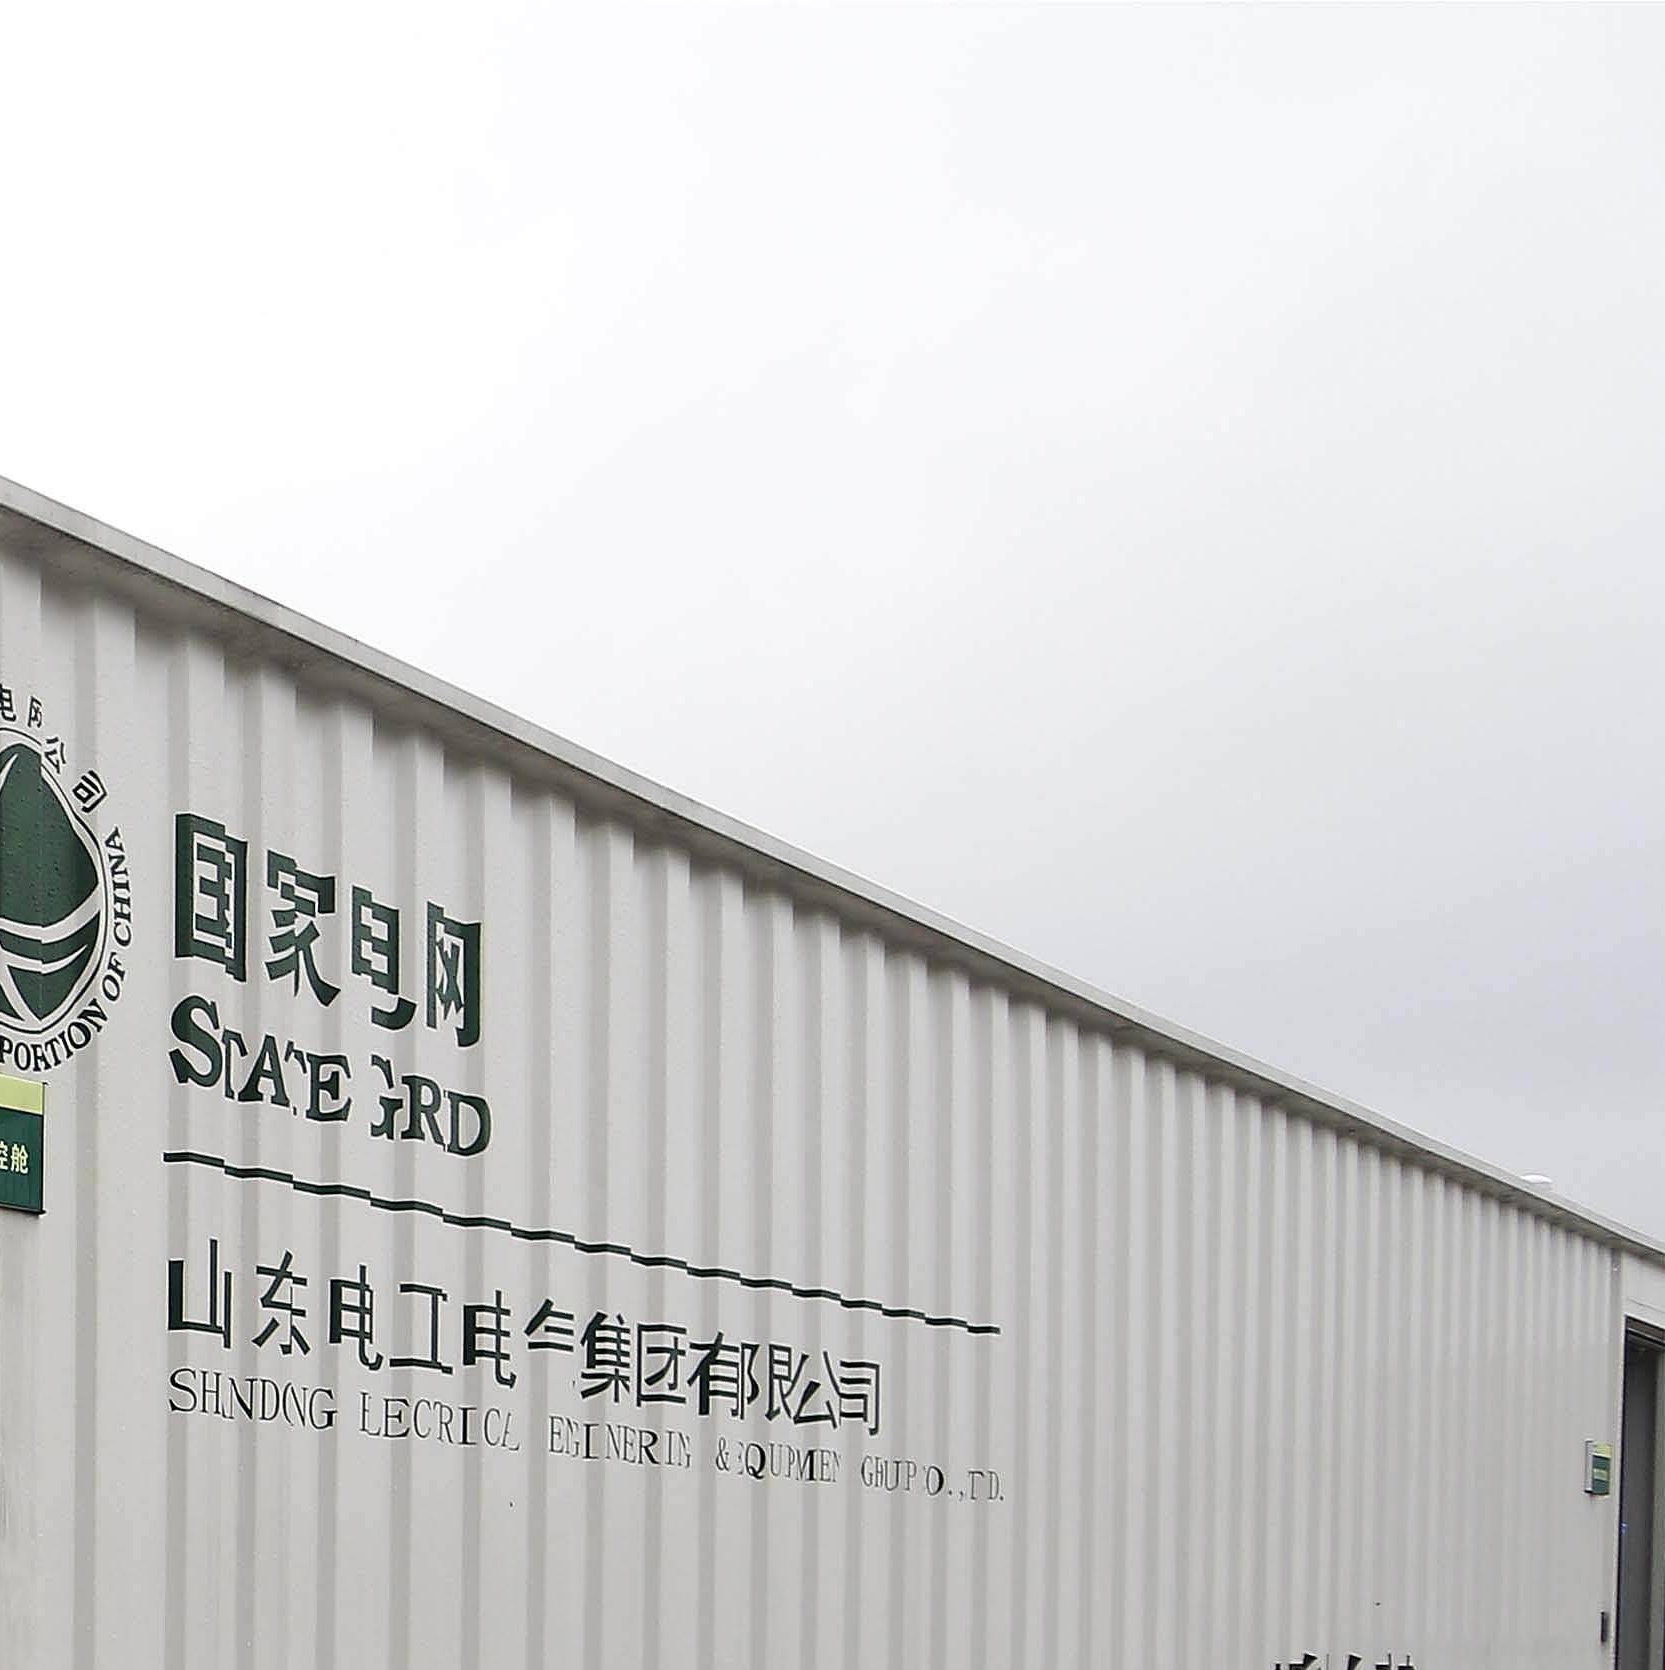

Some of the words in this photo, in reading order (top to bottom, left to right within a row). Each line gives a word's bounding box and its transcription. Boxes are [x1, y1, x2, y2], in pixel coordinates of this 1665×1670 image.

[105, 826, 131, 947] CHINA
[175, 813, 482, 1048] 国家电网
[102, 952, 126, 1001] OF
[169, 995, 351, 1121] STAE
[371, 1054, 492, 1156] GRD
[168, 1238, 881, 1436] 山东电工电气集团有限公司
